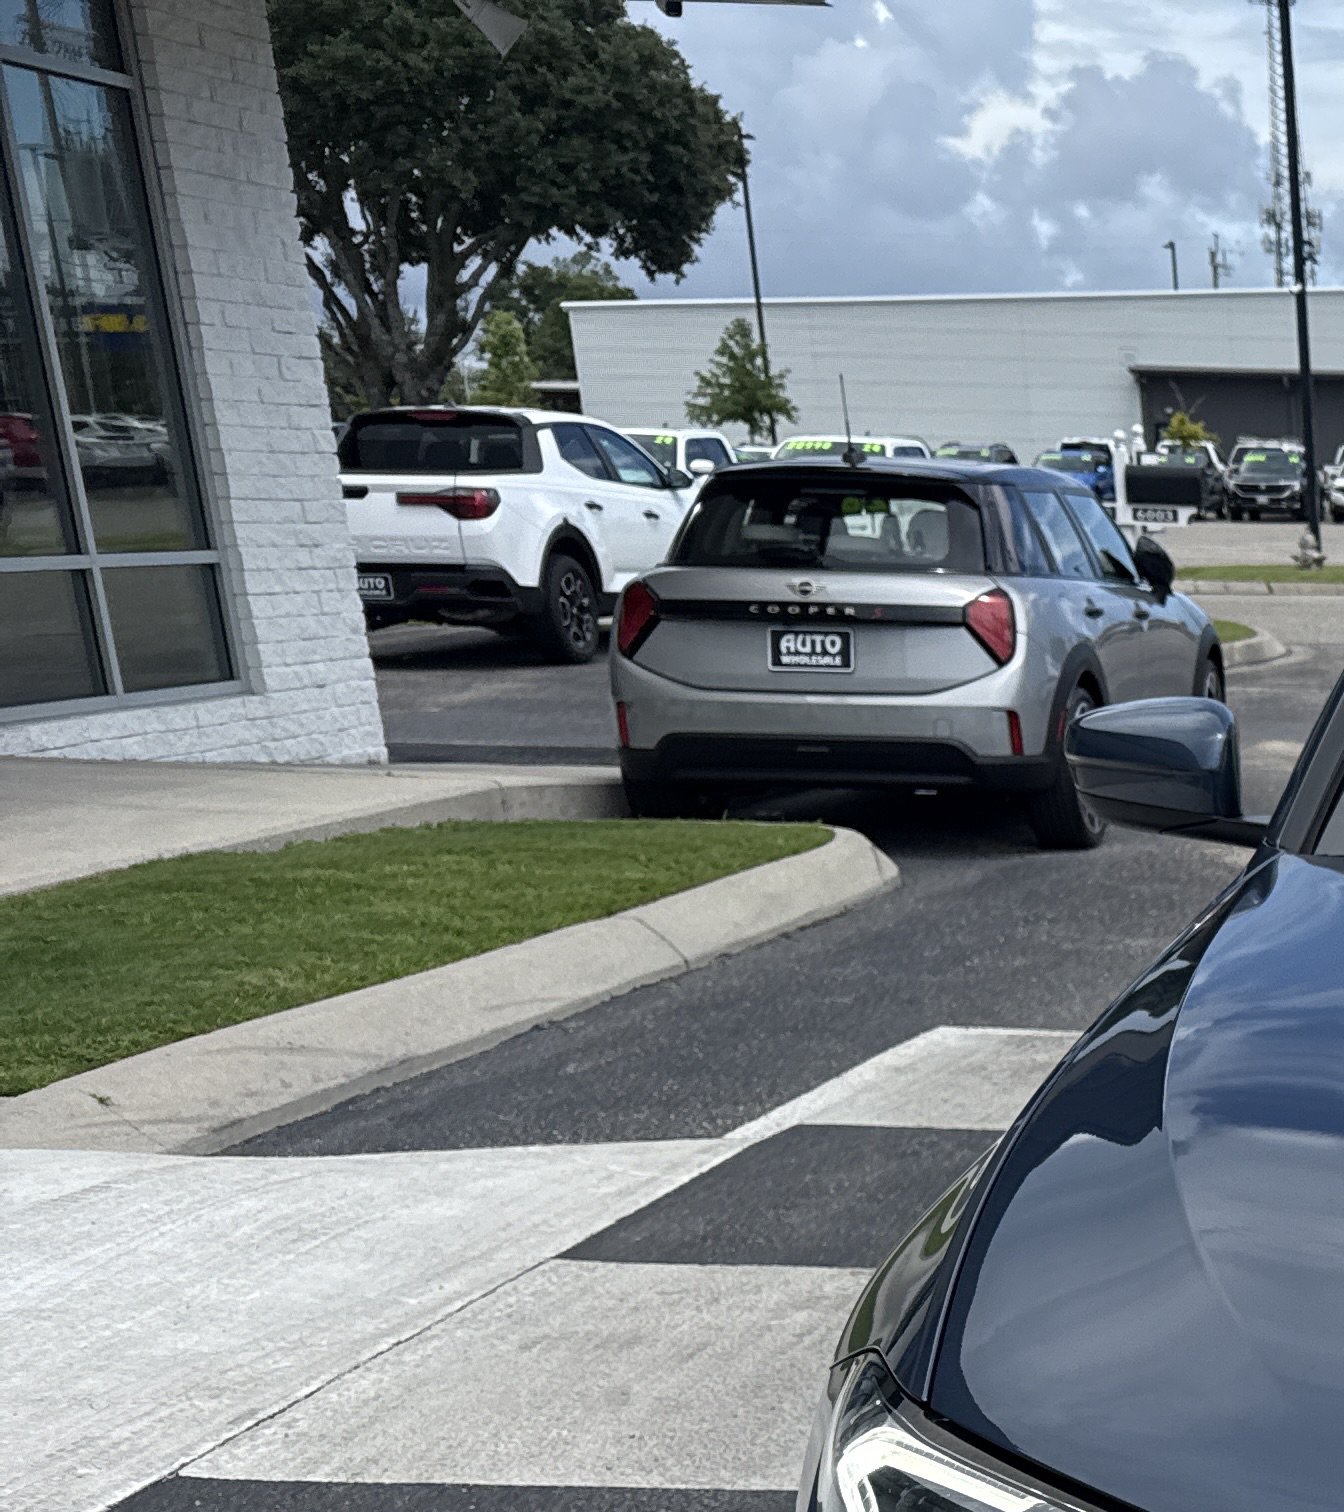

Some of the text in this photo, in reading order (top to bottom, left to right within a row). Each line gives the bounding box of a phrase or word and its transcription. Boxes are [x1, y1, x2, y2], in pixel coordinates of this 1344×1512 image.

[359, 577, 386, 589] UTO
[749, 603, 856, 617] COOPER
[779, 632, 842, 655] AUTO
